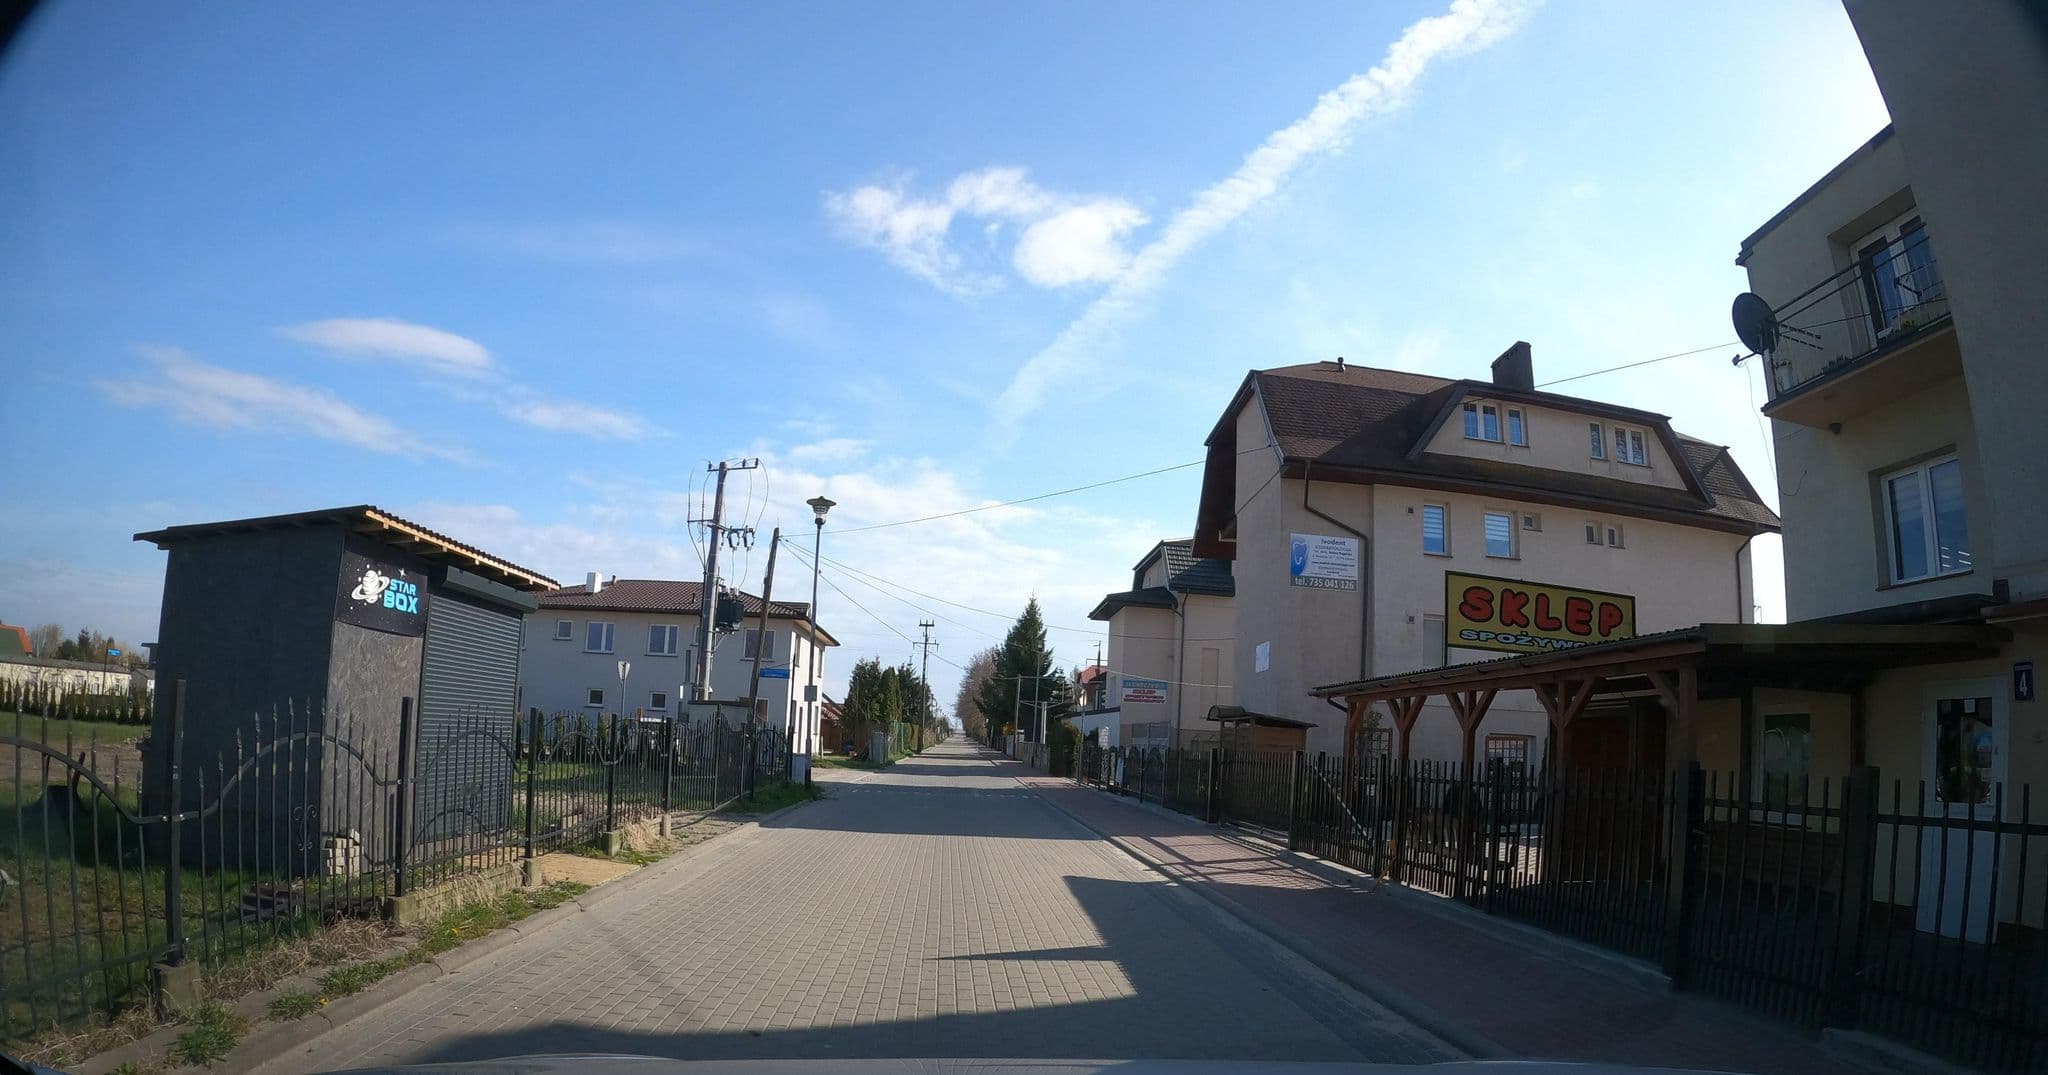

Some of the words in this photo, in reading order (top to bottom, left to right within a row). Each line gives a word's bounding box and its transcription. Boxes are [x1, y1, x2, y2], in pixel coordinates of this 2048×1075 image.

[390, 578, 417, 596] STAR
[1295, 577, 1308, 586] tel.
[1309, 577, 1324, 587] 735
[1341, 580, 1355, 589] 126
[383, 589, 419, 615] BOX
[1459, 586, 1623, 637] SKLEP
[2020, 671, 2028, 697] 4
